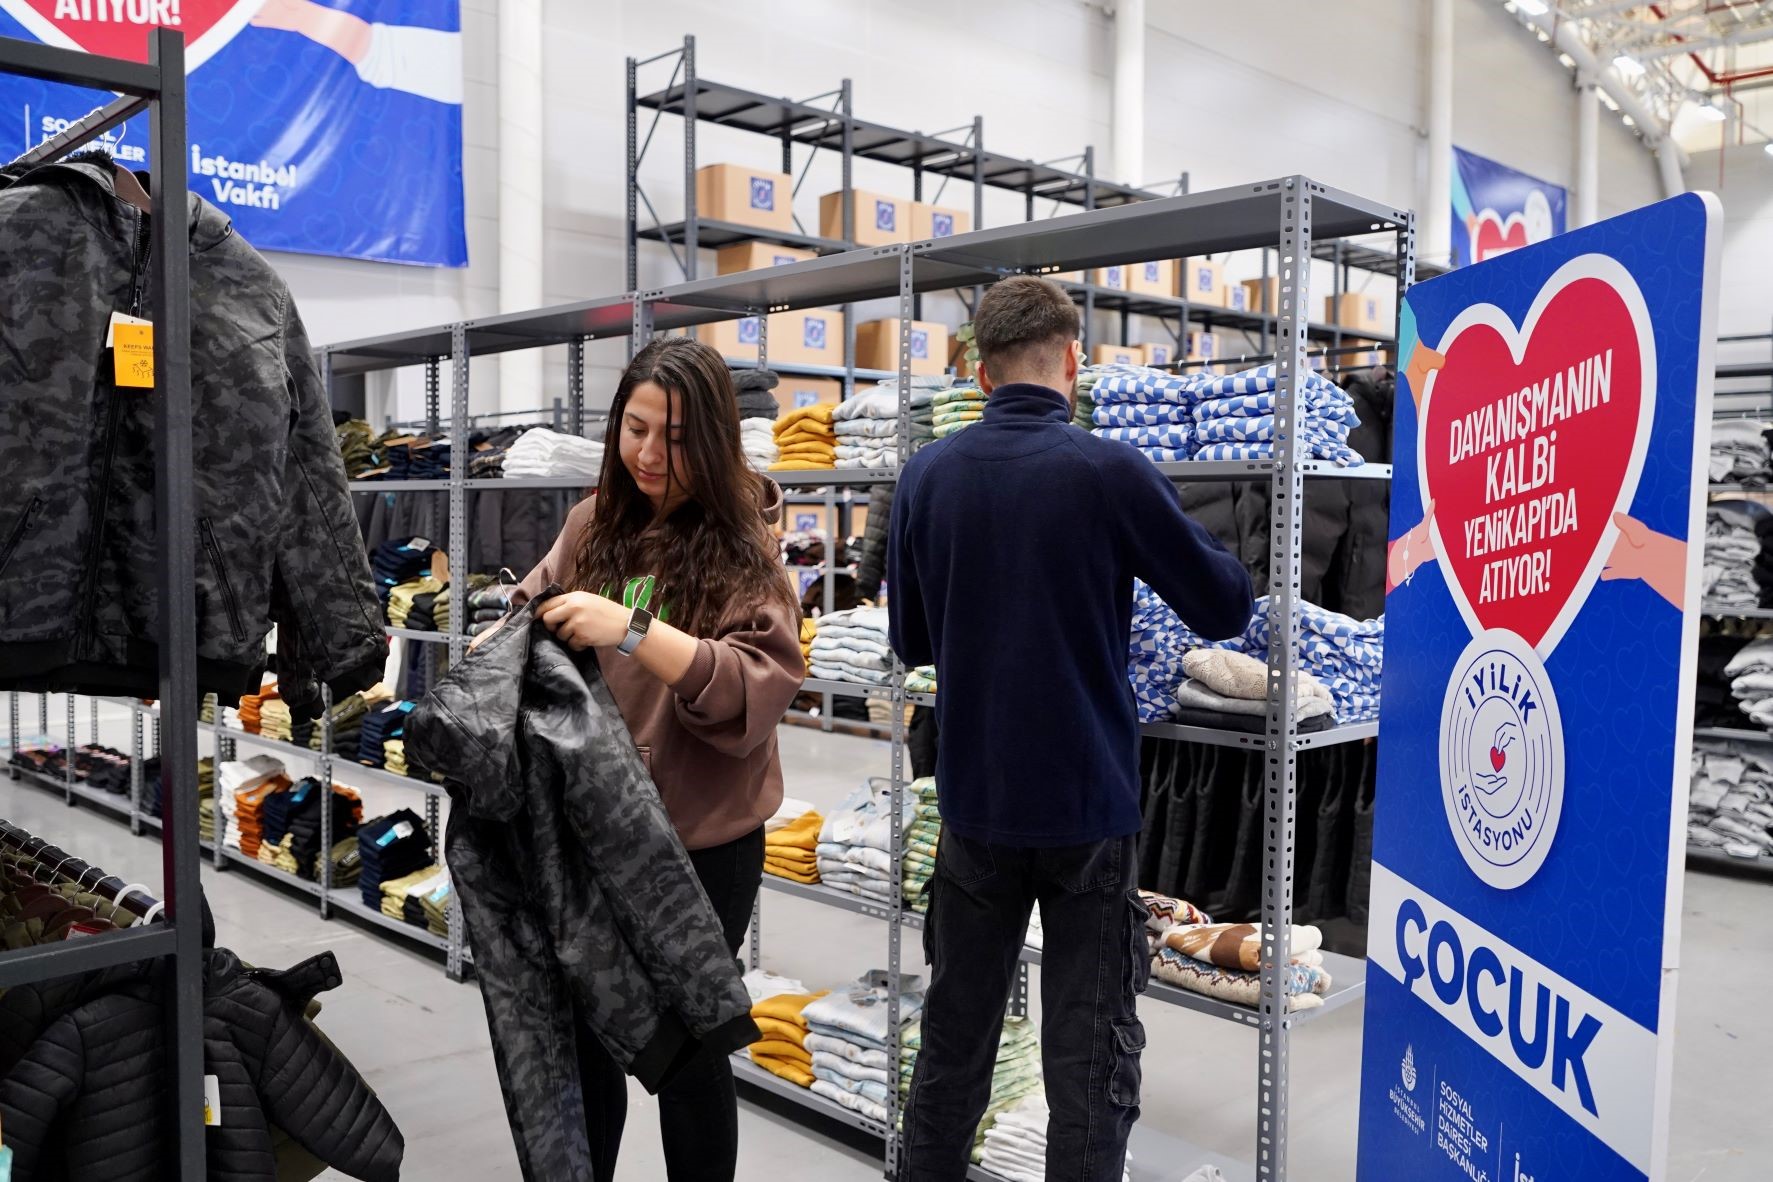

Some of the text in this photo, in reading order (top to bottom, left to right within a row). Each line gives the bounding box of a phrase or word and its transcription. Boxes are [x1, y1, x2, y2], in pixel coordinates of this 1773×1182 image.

[208, 178, 280, 210] Vakfı
[1449, 348, 1612, 465] DAYANIŞMANIN
[1485, 431, 1556, 505] KALBİ
[1479, 548, 1551, 604] ATIYOR!
[1465, 663, 1536, 724] İYİLİK
[1458, 784, 1533, 851] İSTASYONU
[1396, 898, 1603, 1119] ÇOCUK
[1440, 1081, 1474, 1122] SOSYAL
[1440, 1097, 1488, 1153] HİZMETLER
[1437, 1132, 1490, 1182] BAŞKANLIĞ
[1438, 1115, 1472, 1157] DAİRESİ
